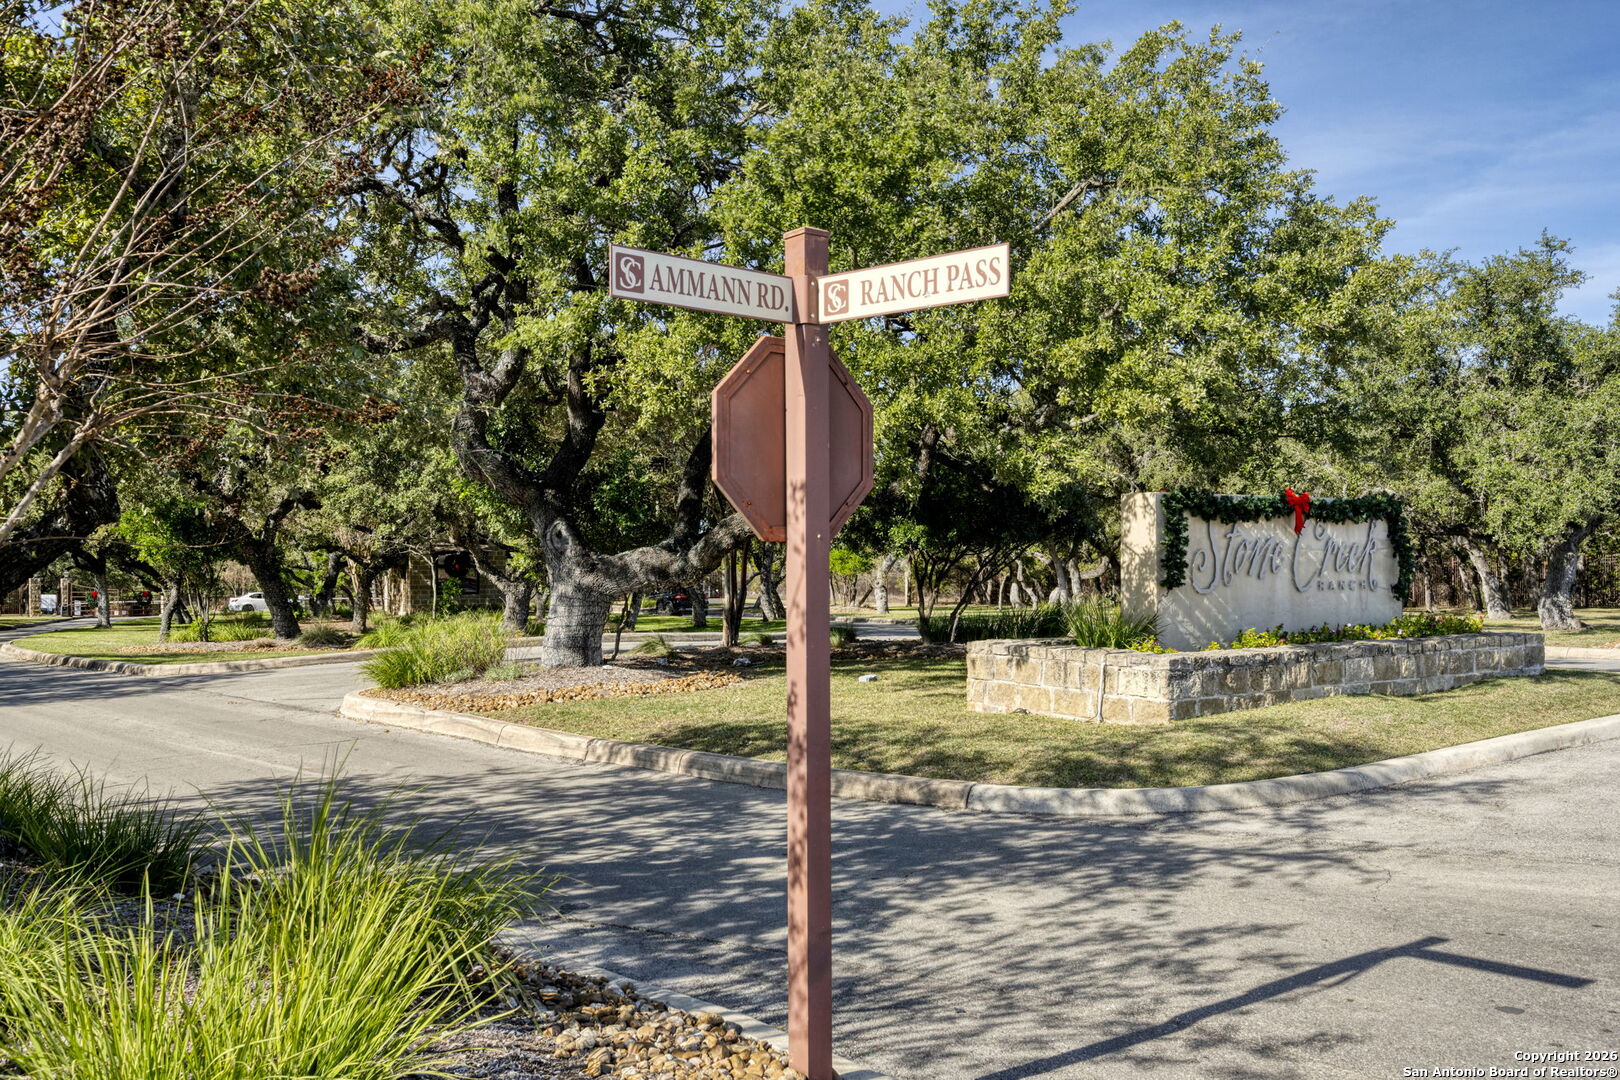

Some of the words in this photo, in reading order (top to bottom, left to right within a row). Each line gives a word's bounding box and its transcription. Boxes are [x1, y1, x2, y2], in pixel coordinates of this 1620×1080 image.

[649, 263, 752, 306] AMMANN
[756, 281, 789, 312] RD.
[860, 267, 940, 306] RANCH
[945, 256, 1002, 293] PASS
[1191, 519, 1287, 594] Stone
[1293, 519, 1378, 592] Creek
[1317, 580, 1366, 591] RANCH
